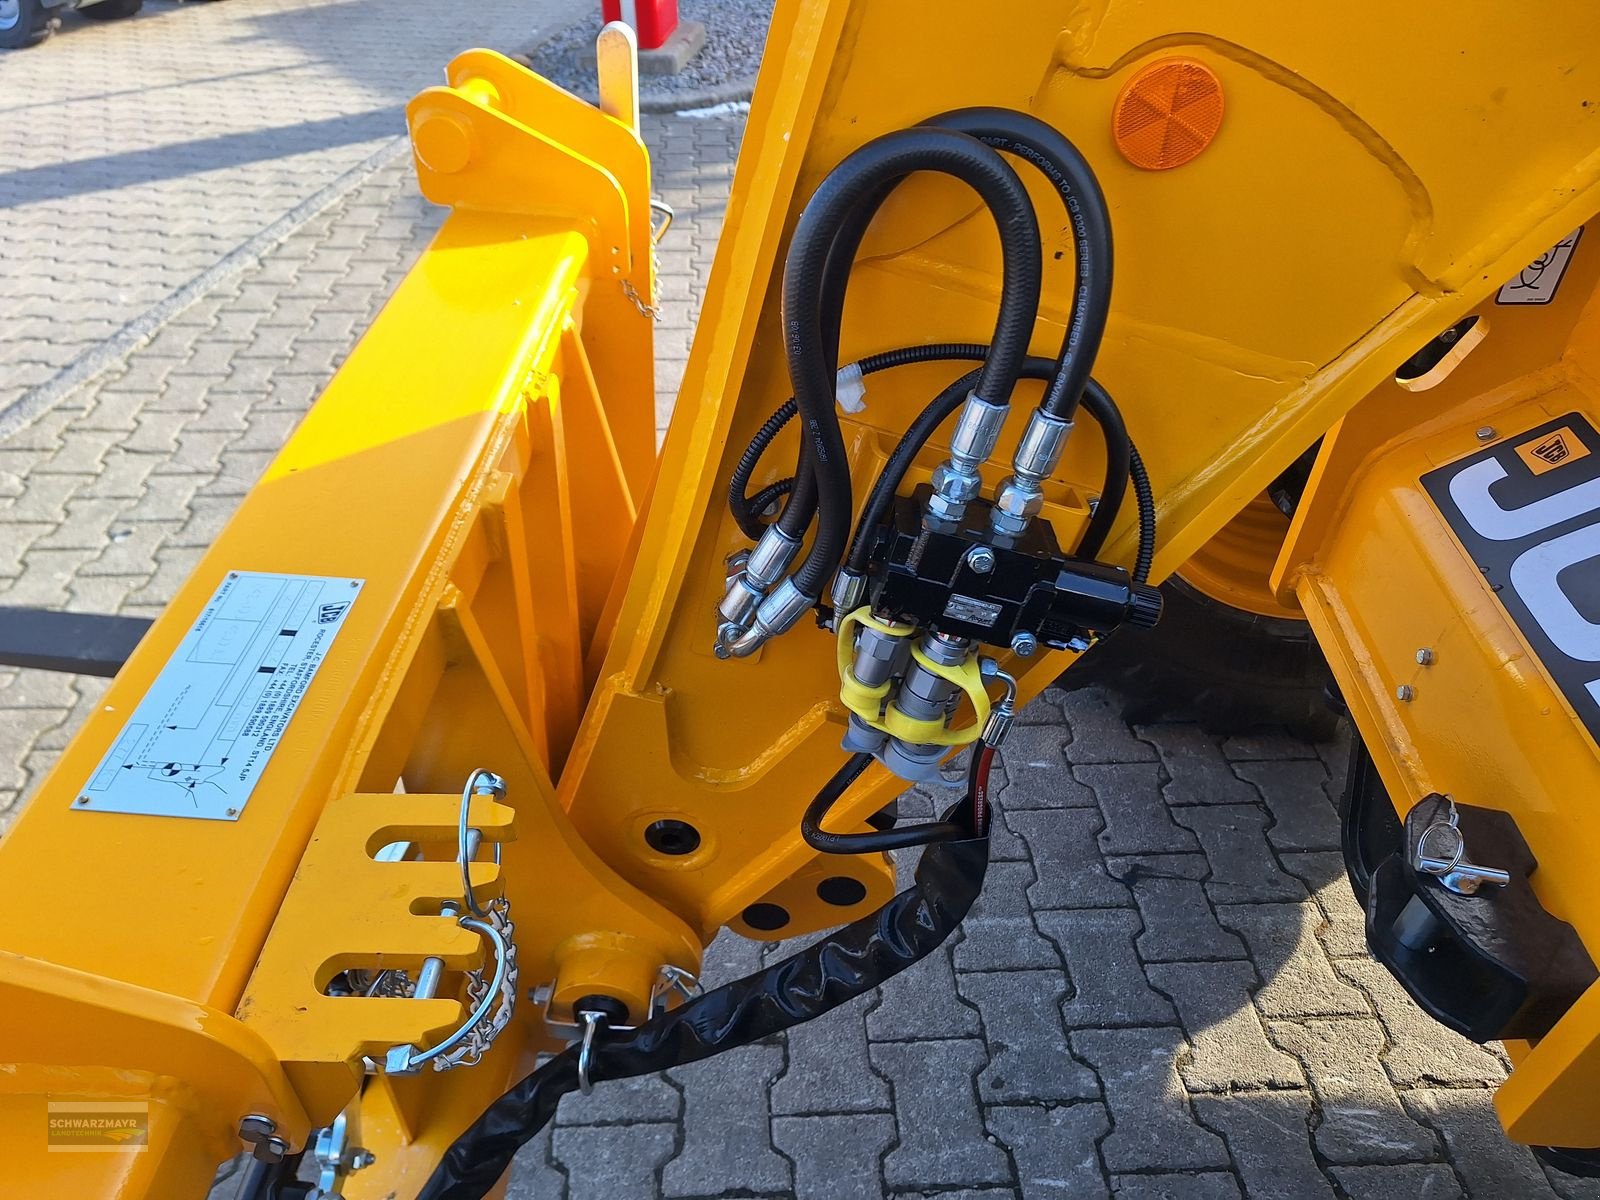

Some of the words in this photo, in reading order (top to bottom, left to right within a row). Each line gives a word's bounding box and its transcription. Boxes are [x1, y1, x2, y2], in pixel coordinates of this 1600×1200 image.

[1013, 142, 1062, 181] PERFORMS
[1058, 178, 1071, 193] TO
[1065, 191, 1079, 214] JCB
[1074, 214, 1088, 237] 0300
[1078, 239, 1089, 277] SERIES
[1069, 286, 1089, 346] CLIMATISED
[1533, 437, 1568, 464] JCB
[319, 602, 348, 624] JCB
[303, 629, 326, 661] ROCESTER,
[274, 662, 308, 713] STAFFORDSHIRE,
[298, 664, 317, 694] BAMFORD
[271, 695, 300, 737] EXCAVATORS
[245, 750, 260, 767] ST14
